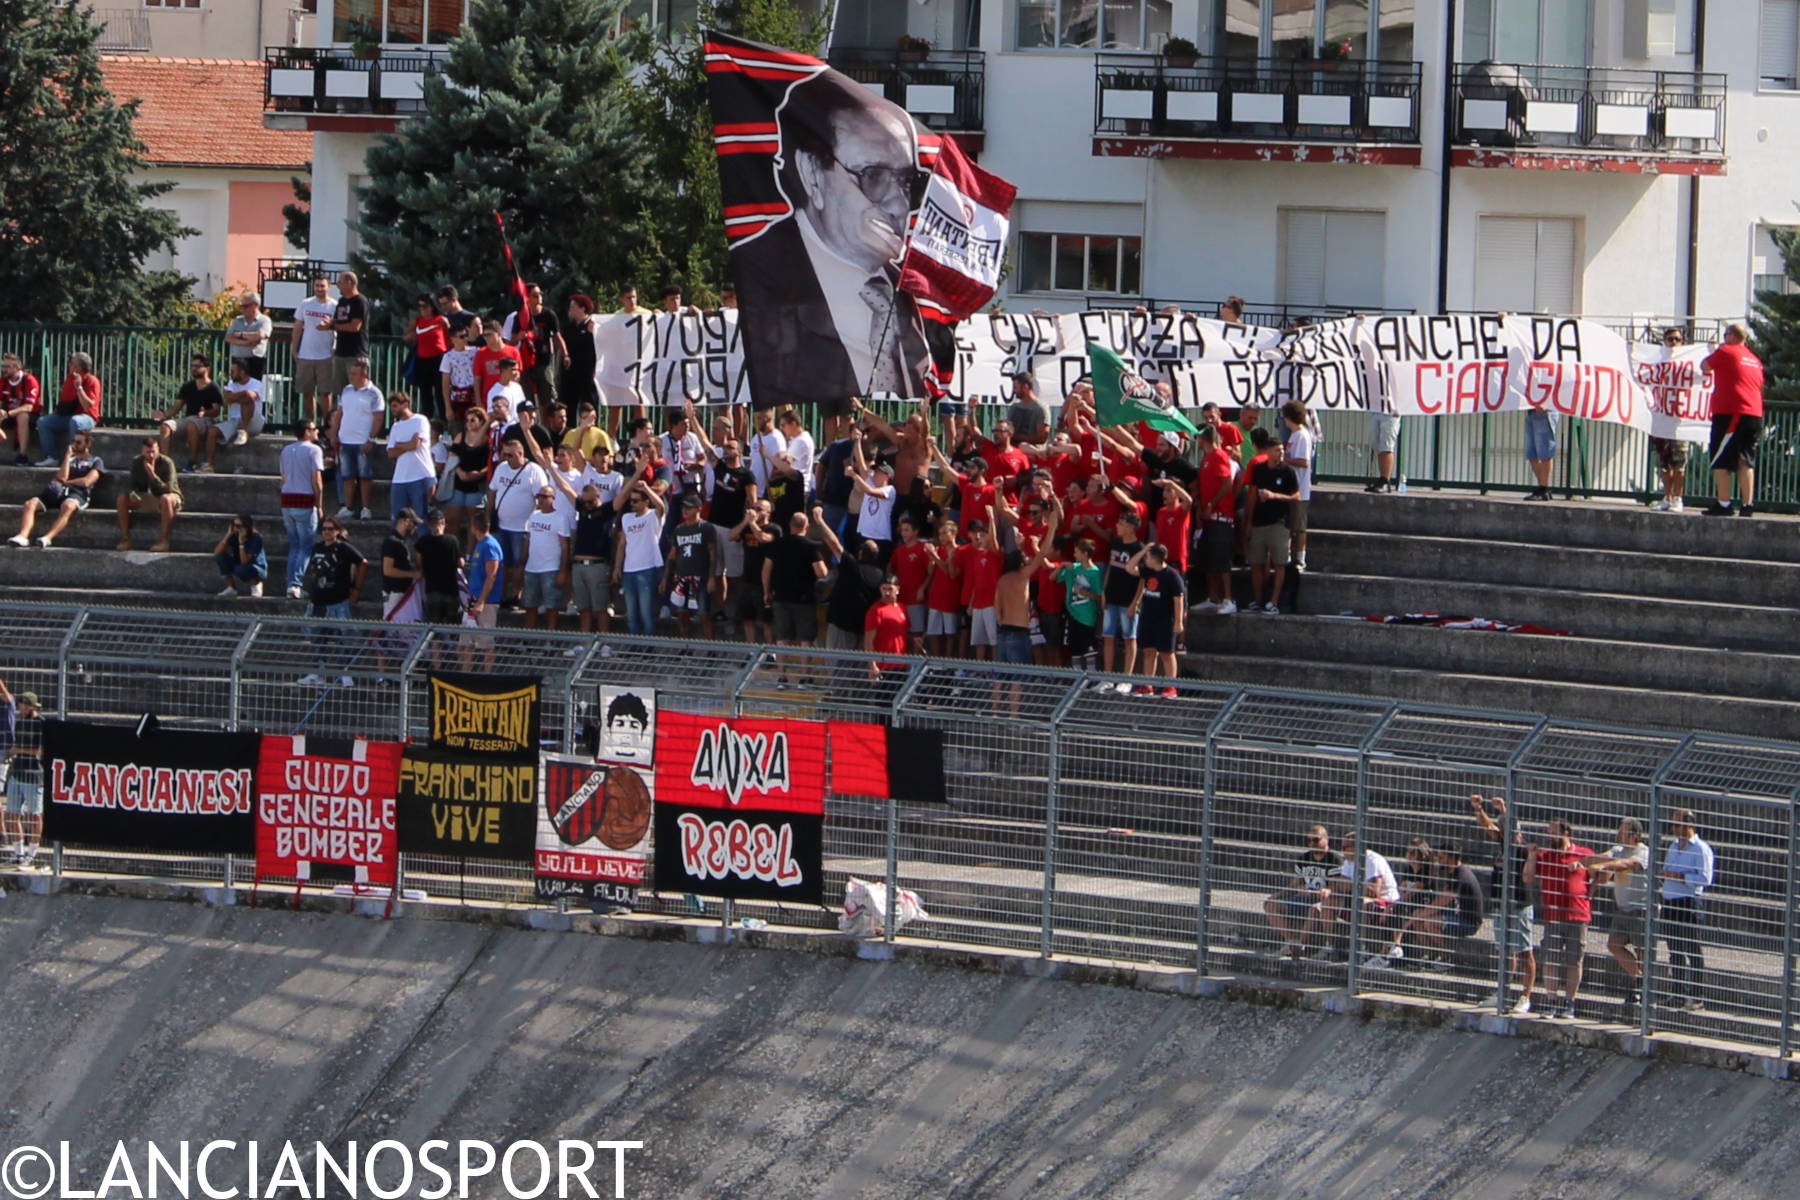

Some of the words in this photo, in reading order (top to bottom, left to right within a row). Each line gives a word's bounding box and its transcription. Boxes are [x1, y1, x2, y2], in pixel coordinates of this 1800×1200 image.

[989, 313, 1057, 356] CHE
[1079, 311, 1205, 358] FORZA
[1375, 315, 1508, 362] ANCHE
[1532, 317, 1582, 362] DA
[1637, 360, 1694, 388] CURVA
[431, 676, 537, 748] FRENTANI
[446, 736, 466, 747] NON
[468, 738, 518, 752] TESSERATI
[52, 758, 252, 815] LANCIANESI
[284, 759, 371, 796] GUIDO
[556, 772, 602, 826] LANCIANO
[259, 792, 397, 831] GENERALE
[276, 825, 384, 864] BOMBER
[677, 812, 803, 888] REBEL
